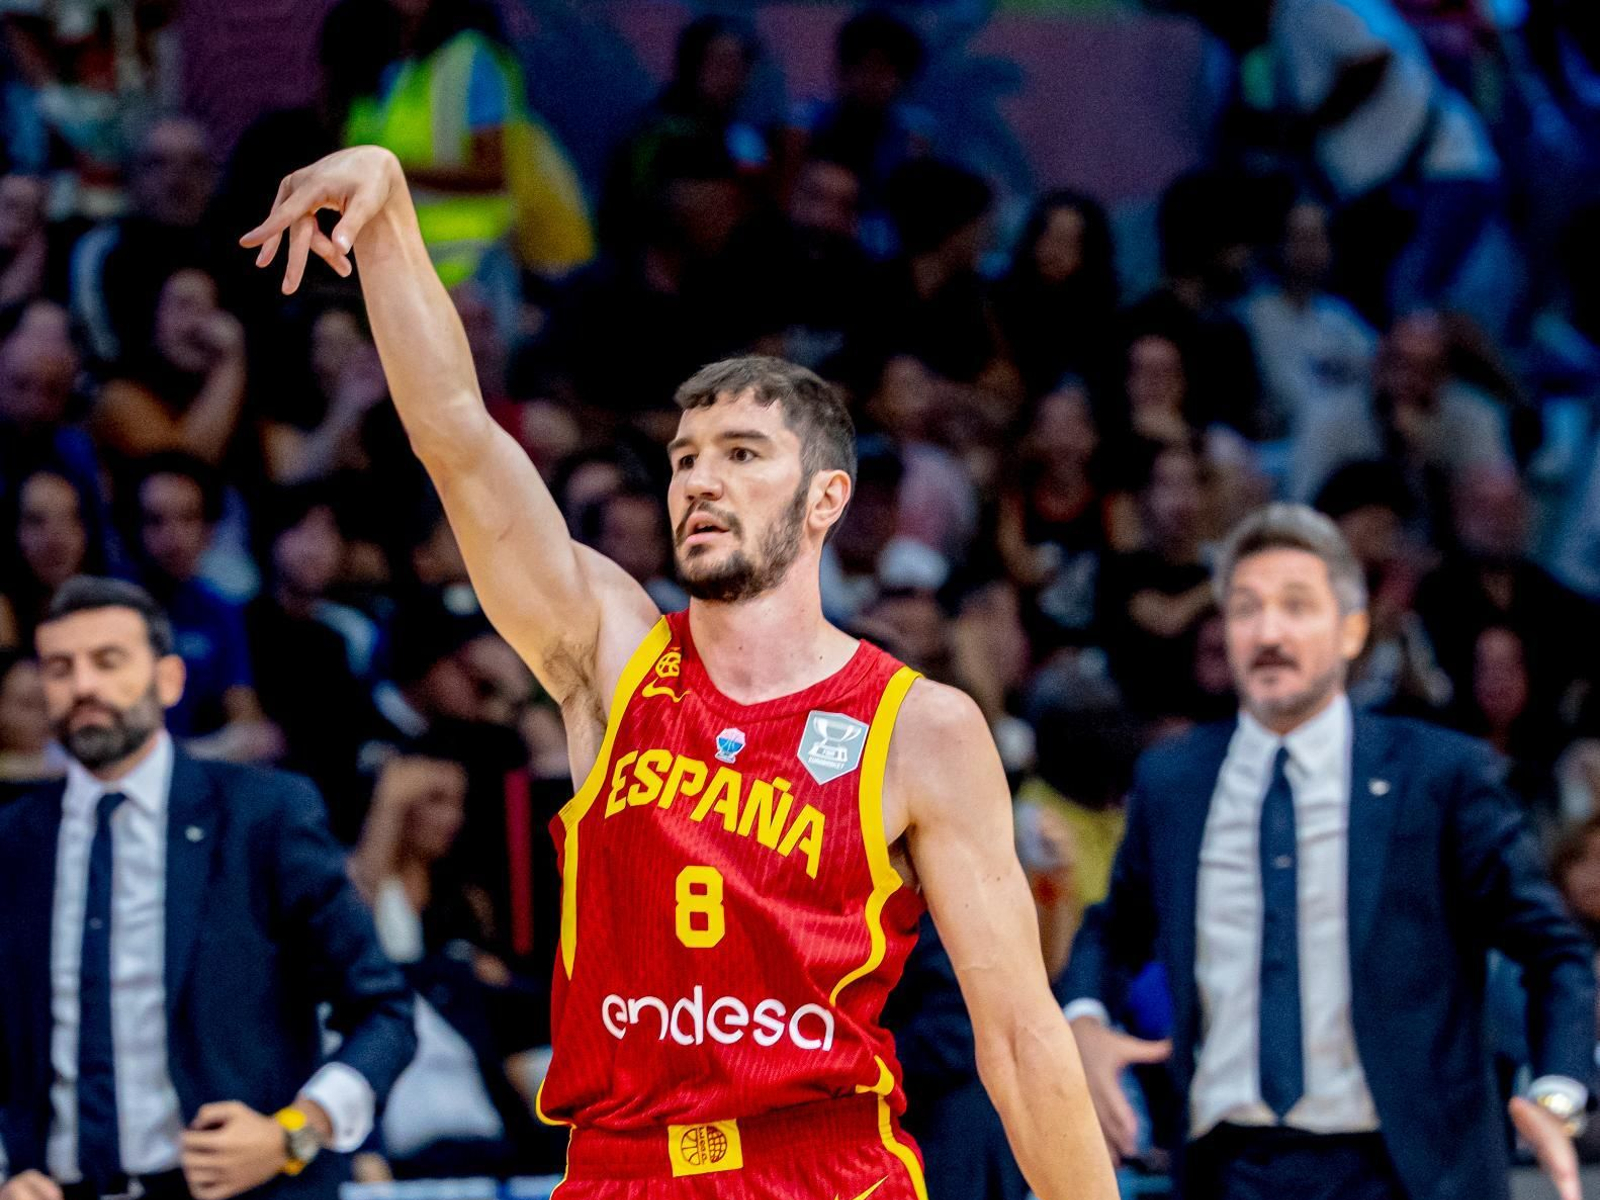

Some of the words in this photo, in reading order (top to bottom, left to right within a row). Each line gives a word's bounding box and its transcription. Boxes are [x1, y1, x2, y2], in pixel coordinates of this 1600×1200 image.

[604, 749, 826, 880] ESPAÑA
[675, 865, 725, 948] 8
[602, 985, 835, 1051] endesa
